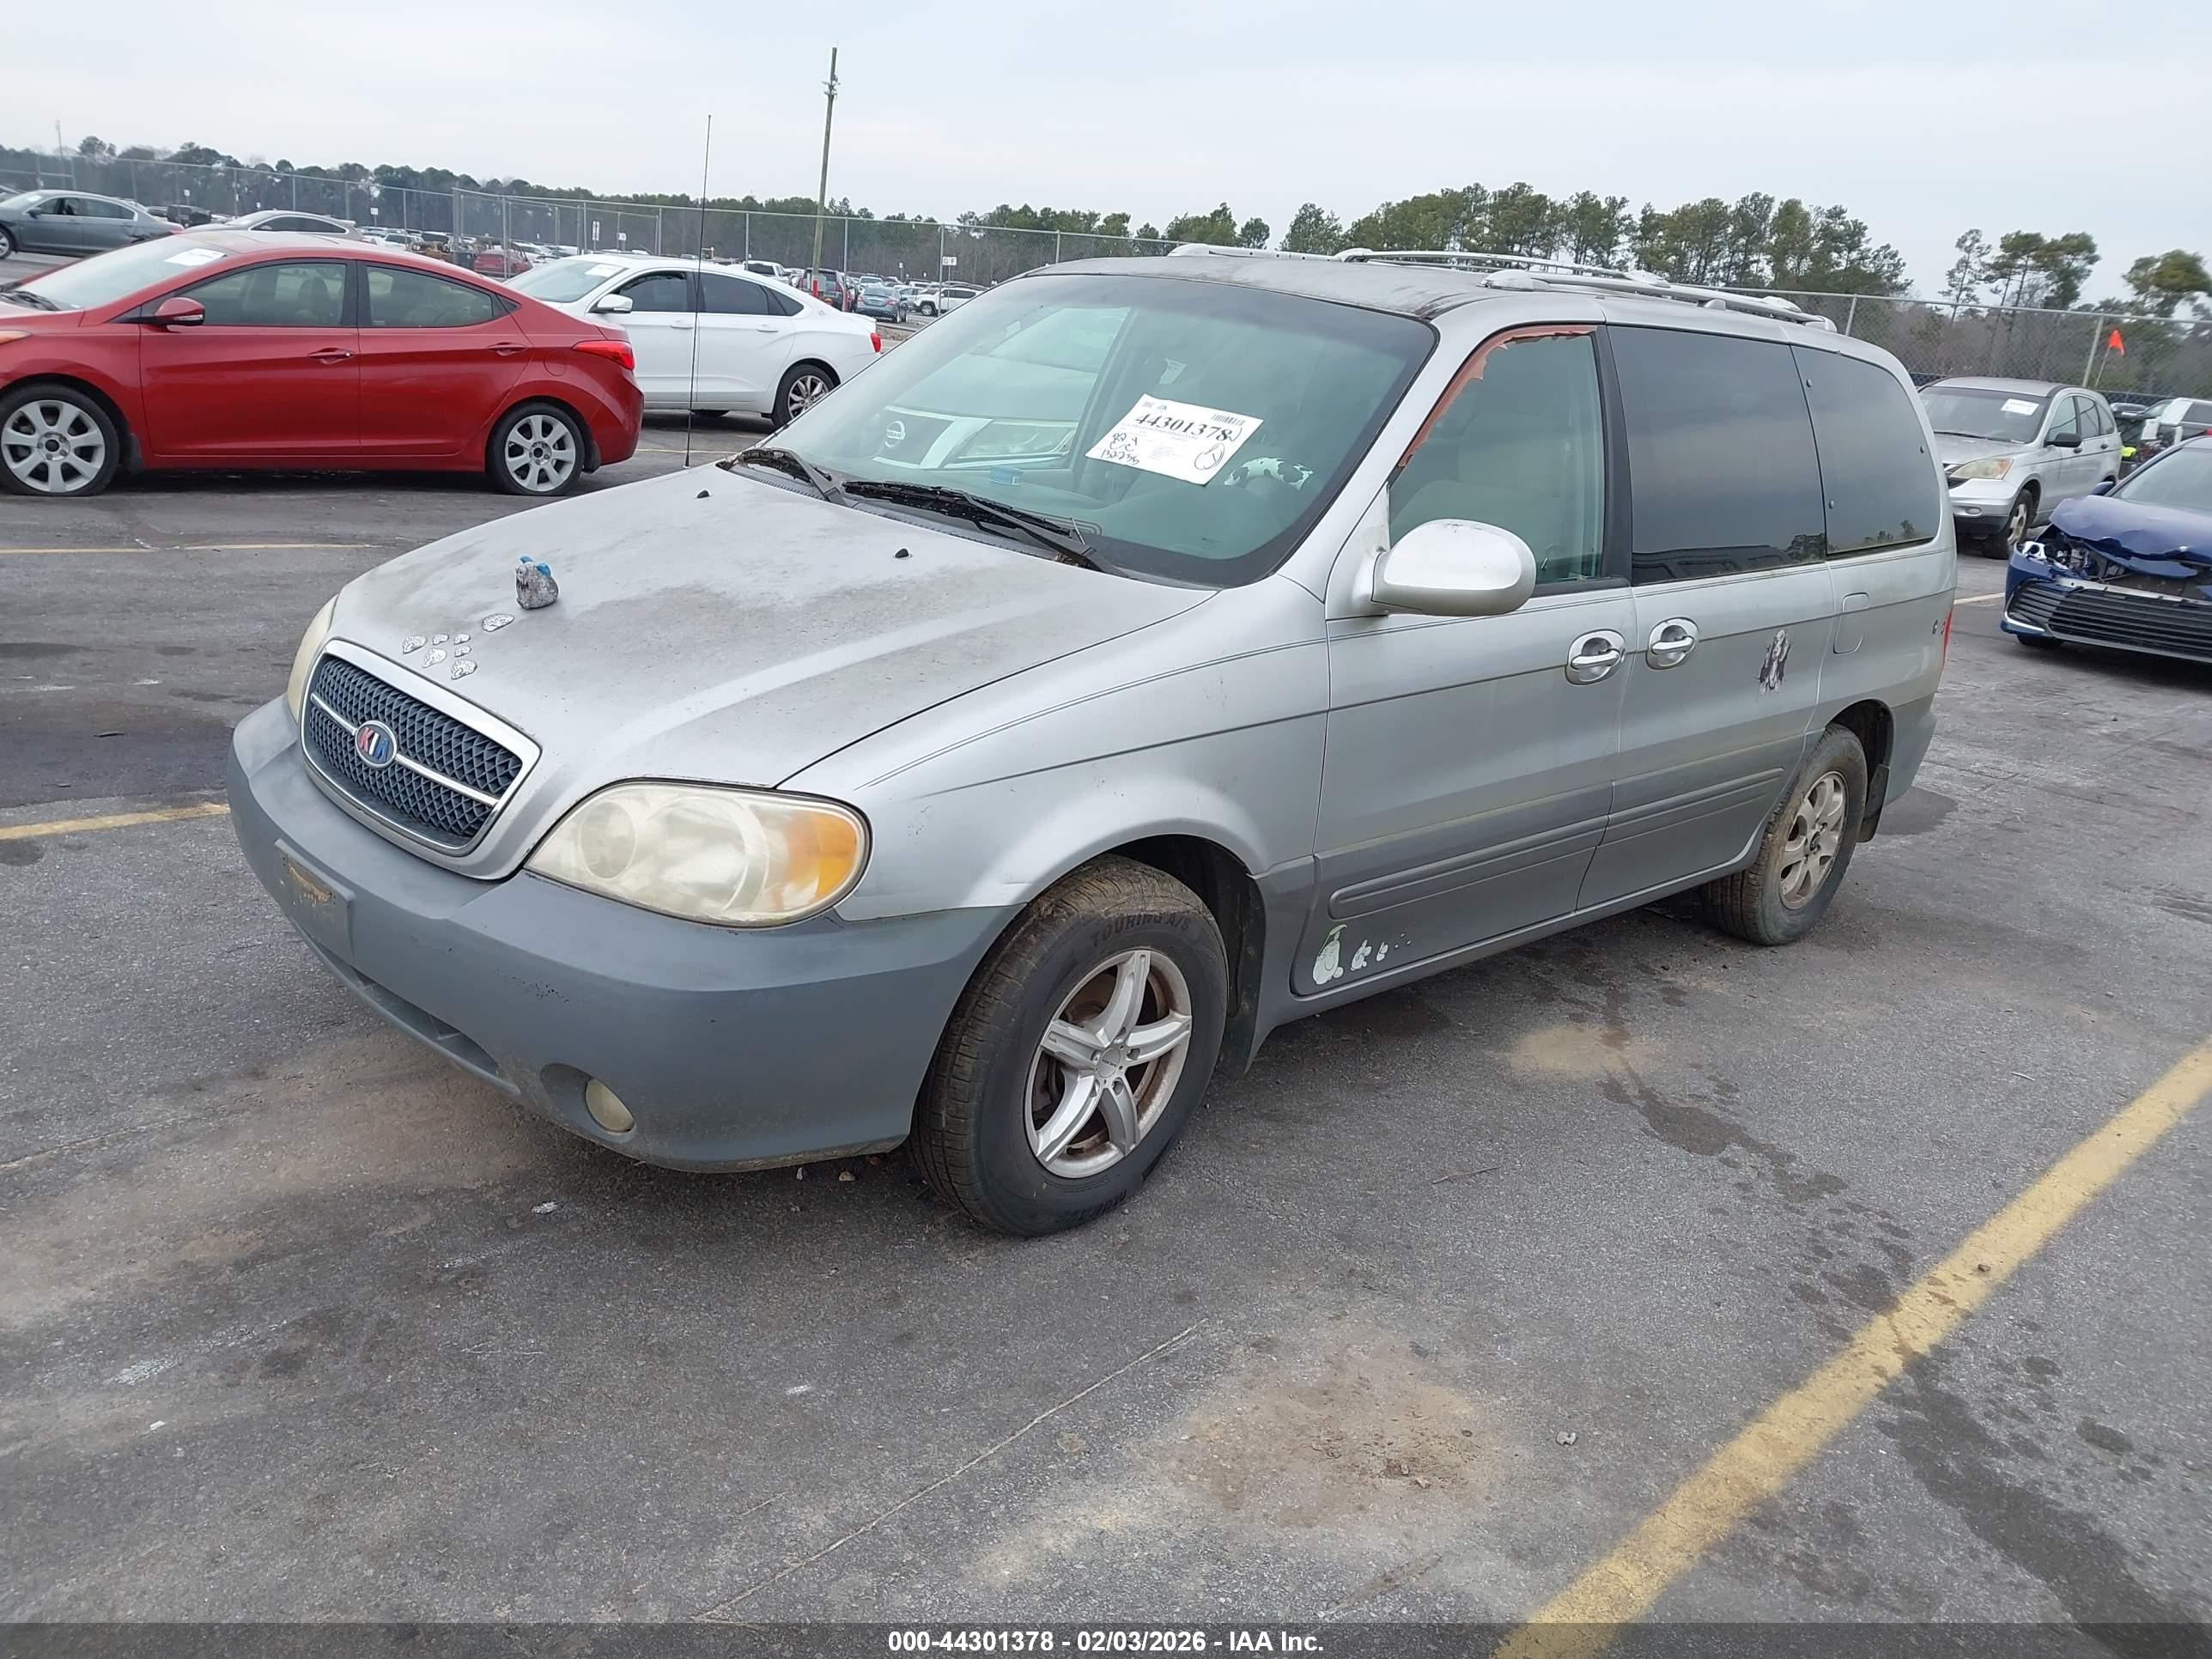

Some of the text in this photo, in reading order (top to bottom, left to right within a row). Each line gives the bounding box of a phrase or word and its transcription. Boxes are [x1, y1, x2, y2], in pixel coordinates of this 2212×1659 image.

[1136, 413, 1232, 441] 44301378
[358, 727, 389, 763] KIA
[1091, 914, 1162, 947] TOURING
